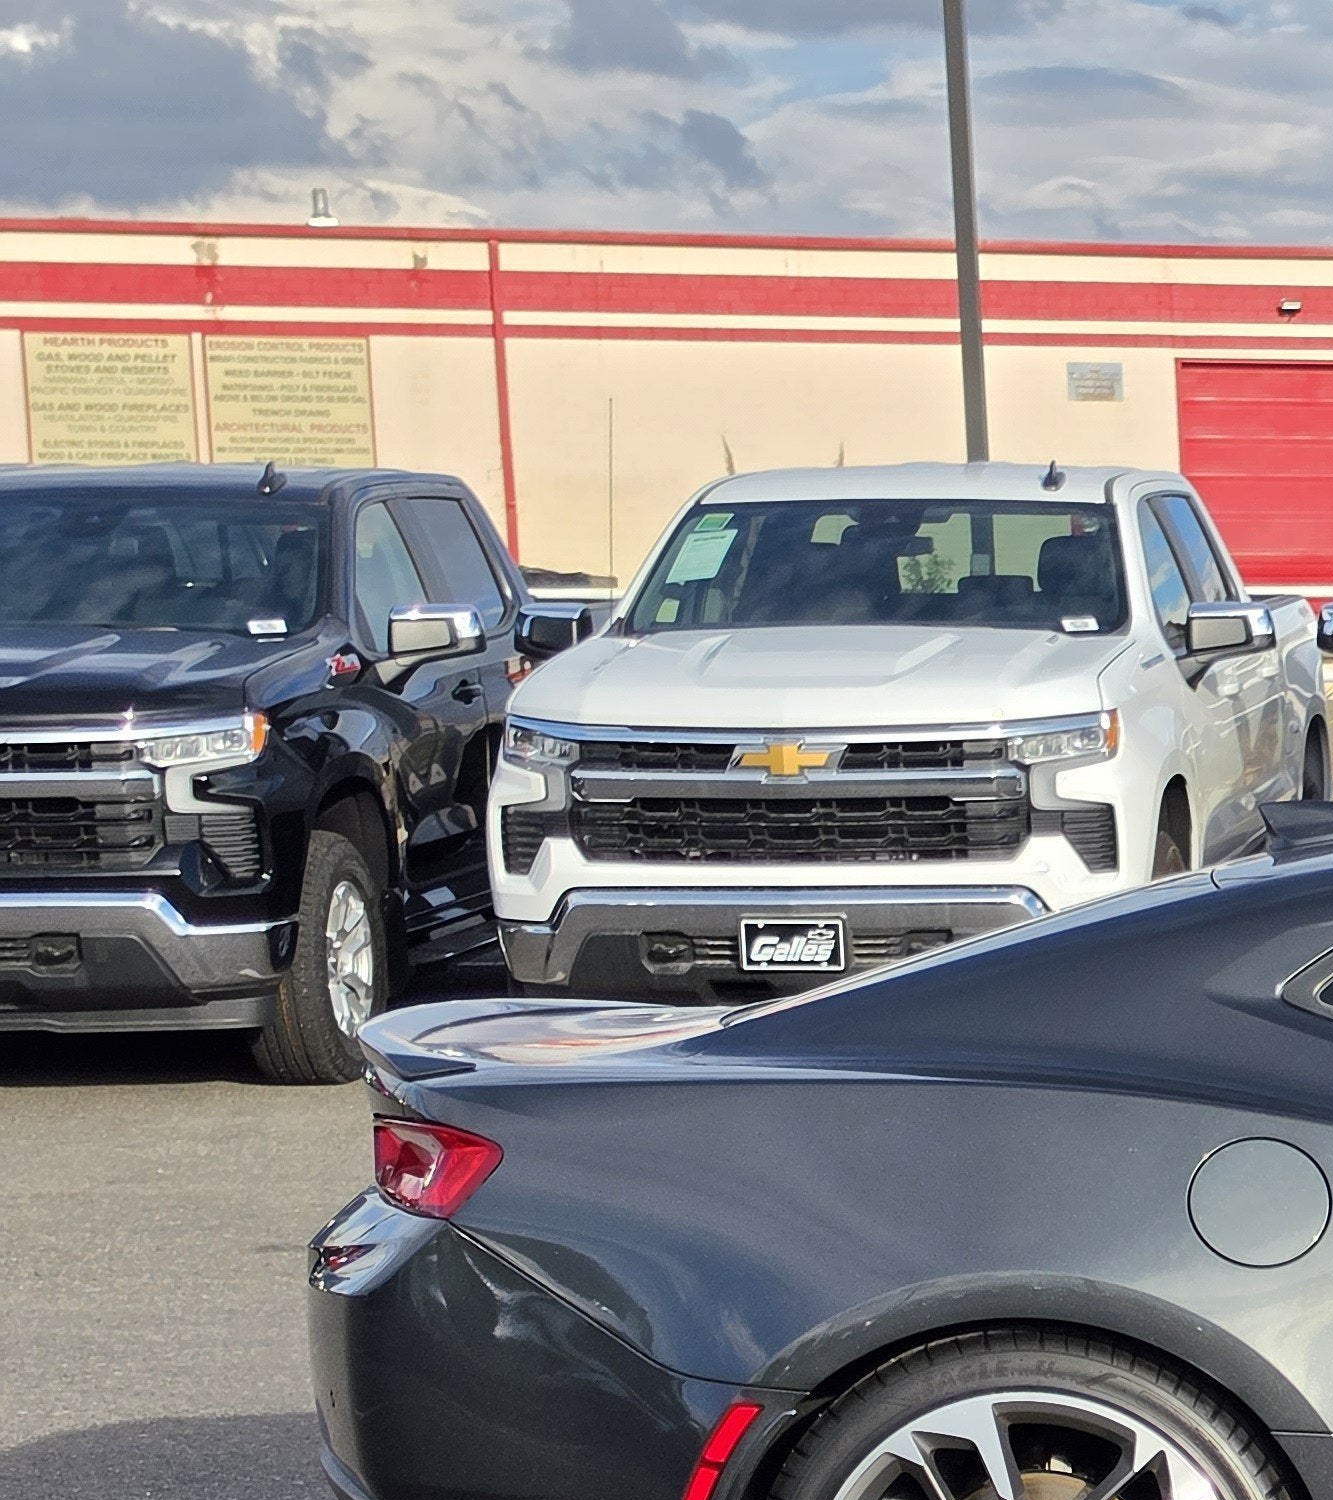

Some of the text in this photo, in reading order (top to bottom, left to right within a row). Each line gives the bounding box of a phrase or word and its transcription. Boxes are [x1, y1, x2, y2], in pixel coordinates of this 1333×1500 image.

[43, 337, 169, 348] HEARTH PRODUCTS
[256, 341, 305, 352] CONTROL
[308, 342, 364, 353] PRODUCTS
[67, 352, 104, 363] WOOD
[106, 353, 132, 363] AND
[133, 353, 177, 363] PELLET
[45, 364, 170, 375] STOVES AND INSERTS
[30, 401, 189, 413] GAS AND WOOD FIREPLACES
[252, 408, 331, 418] TRENCH DRAINS
[214, 421, 369, 435] ARCHITECTURAL PRODUCTS
[38, 451, 66, 460] WOOD
[750, 935, 835, 962] Galles
